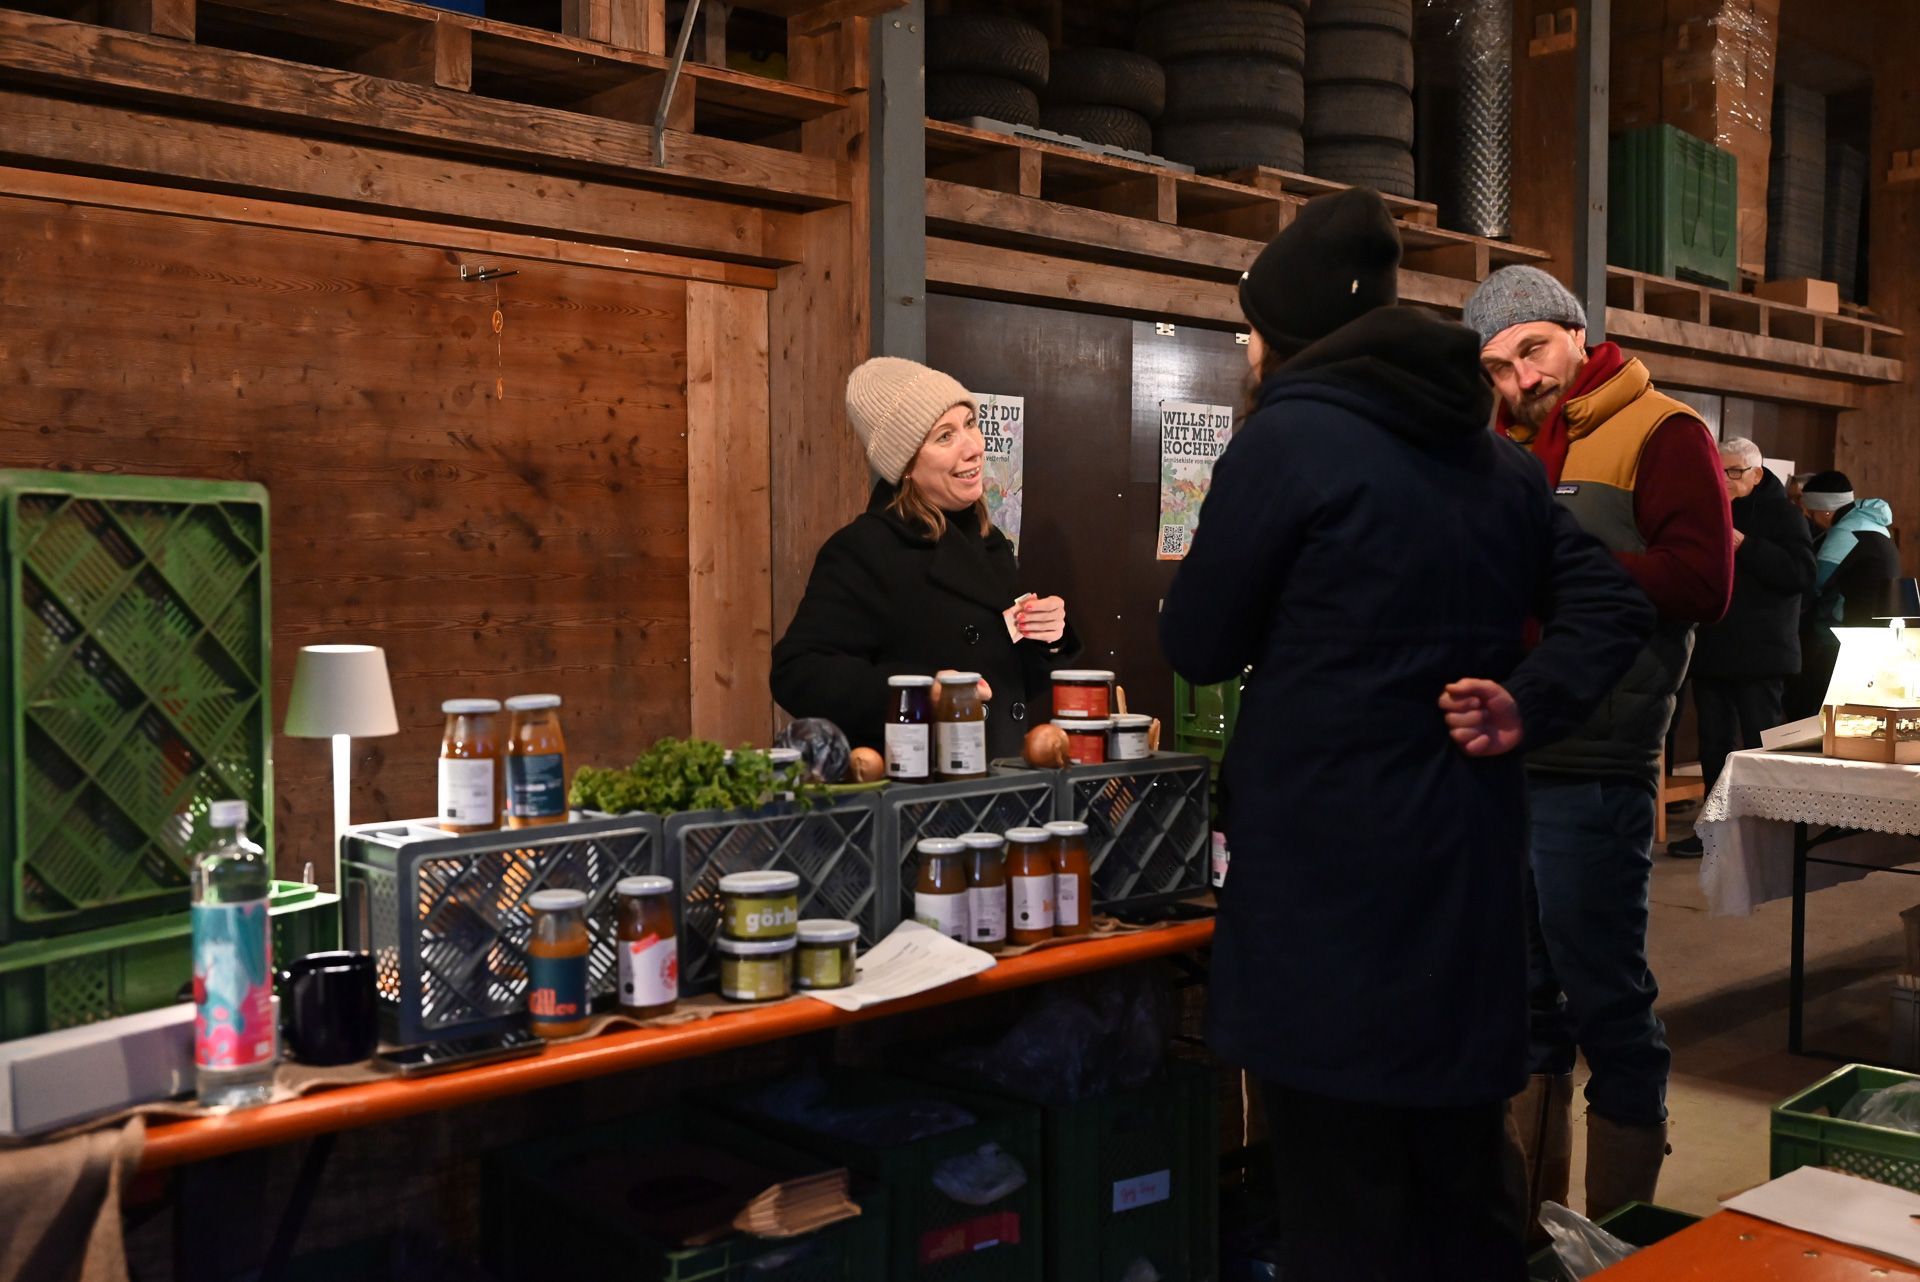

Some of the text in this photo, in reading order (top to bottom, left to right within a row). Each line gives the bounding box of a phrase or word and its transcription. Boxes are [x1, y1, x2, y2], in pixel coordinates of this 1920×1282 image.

[1001, 406, 1020, 421] DU
[1163, 411, 1230, 428] WILLST DU
[1163, 426, 1215, 442] MIT MIR
[1163, 441, 1224, 456] KOCHEN?
